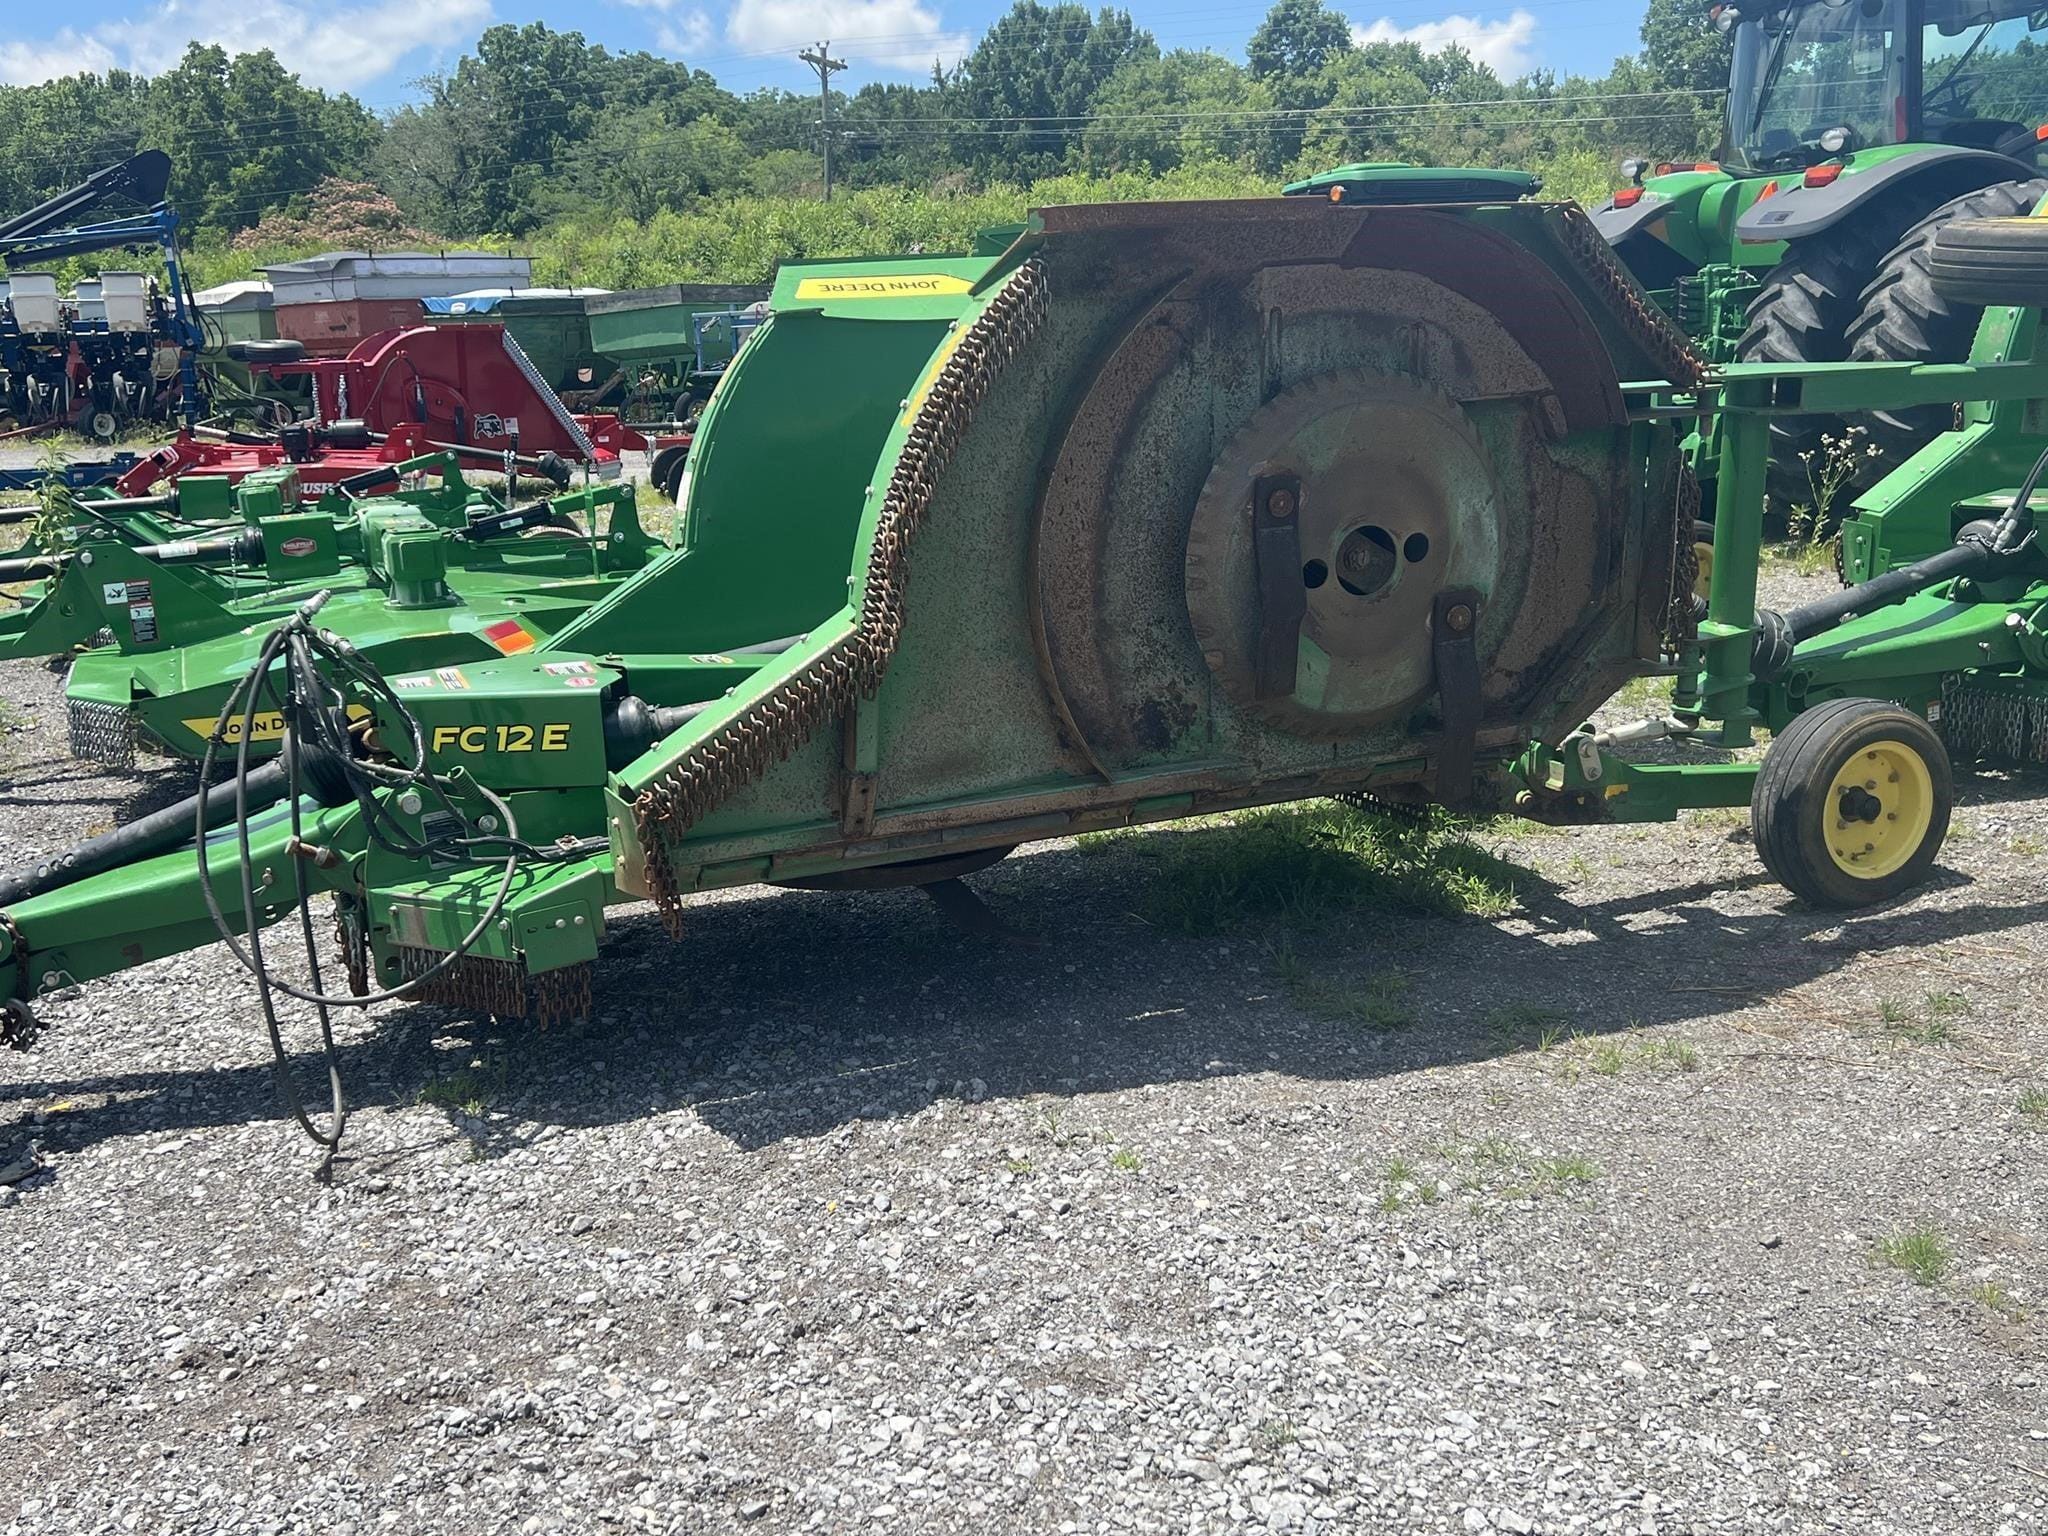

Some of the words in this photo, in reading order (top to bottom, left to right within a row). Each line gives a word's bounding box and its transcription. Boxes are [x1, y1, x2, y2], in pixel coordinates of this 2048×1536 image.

[819, 282, 886, 292] DEERE
[890, 280, 940, 290] JOHN
[432, 725, 488, 753] FC
[496, 723, 535, 753] 12
[541, 722, 572, 752] E
